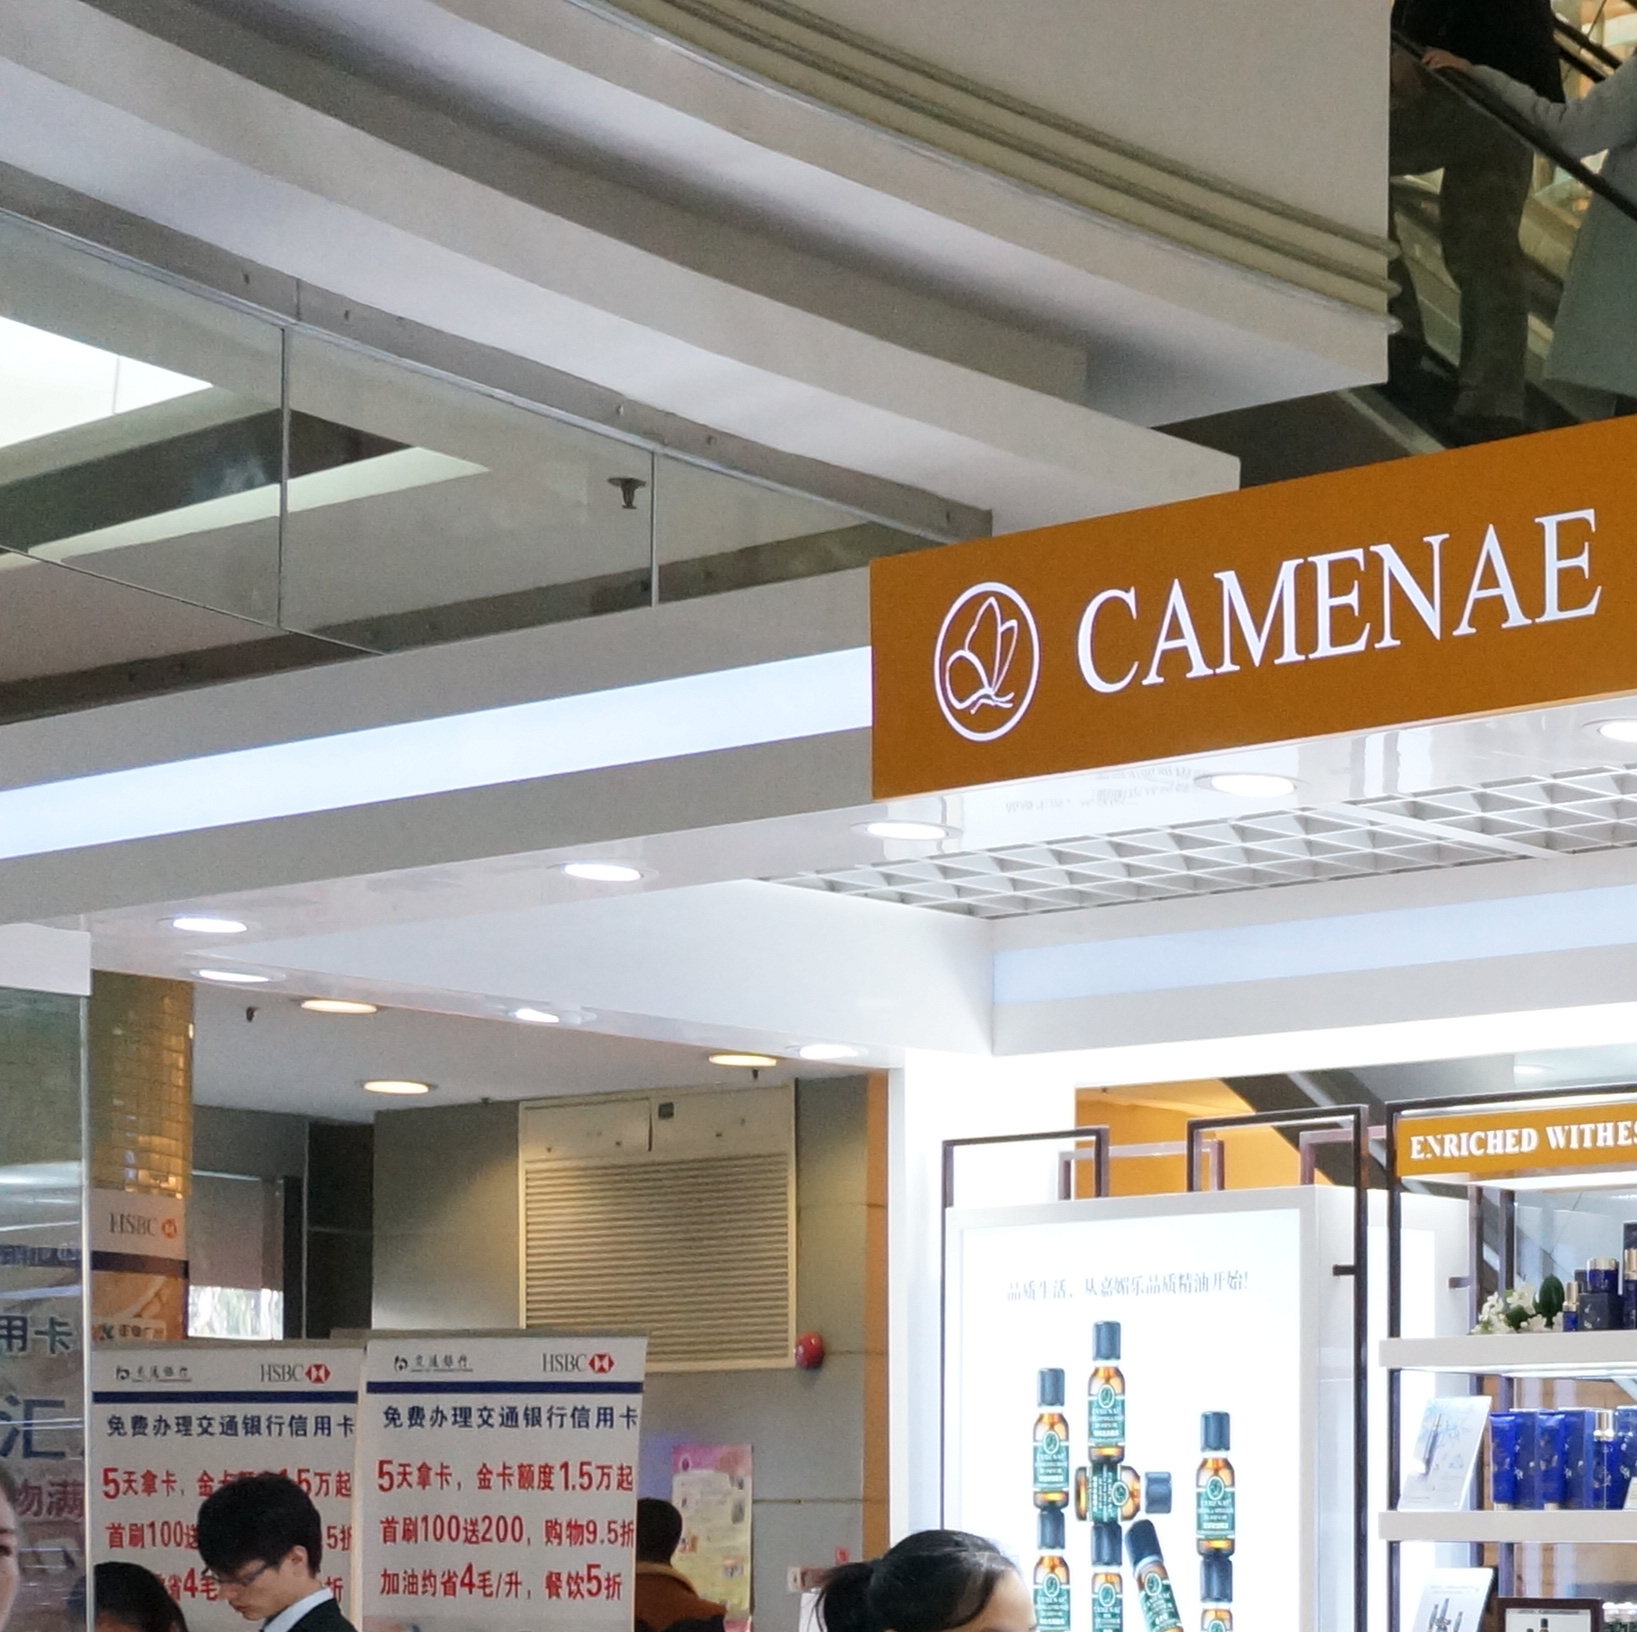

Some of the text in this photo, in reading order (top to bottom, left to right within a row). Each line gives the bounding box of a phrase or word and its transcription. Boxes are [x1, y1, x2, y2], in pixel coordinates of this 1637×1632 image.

[1076, 506, 1605, 695] CAMENAE
[1409, 1127, 1540, 1161] ENRICHED
[109, 1213, 158, 1237] HSBC
[260, 1363, 304, 1382] HSBC
[542, 1353, 587, 1373] HSBC
[107, 1413, 356, 1438] 免费办理交通银行信用卡
[383, 1404, 639, 1430] 免费办理交通银行信用卡
